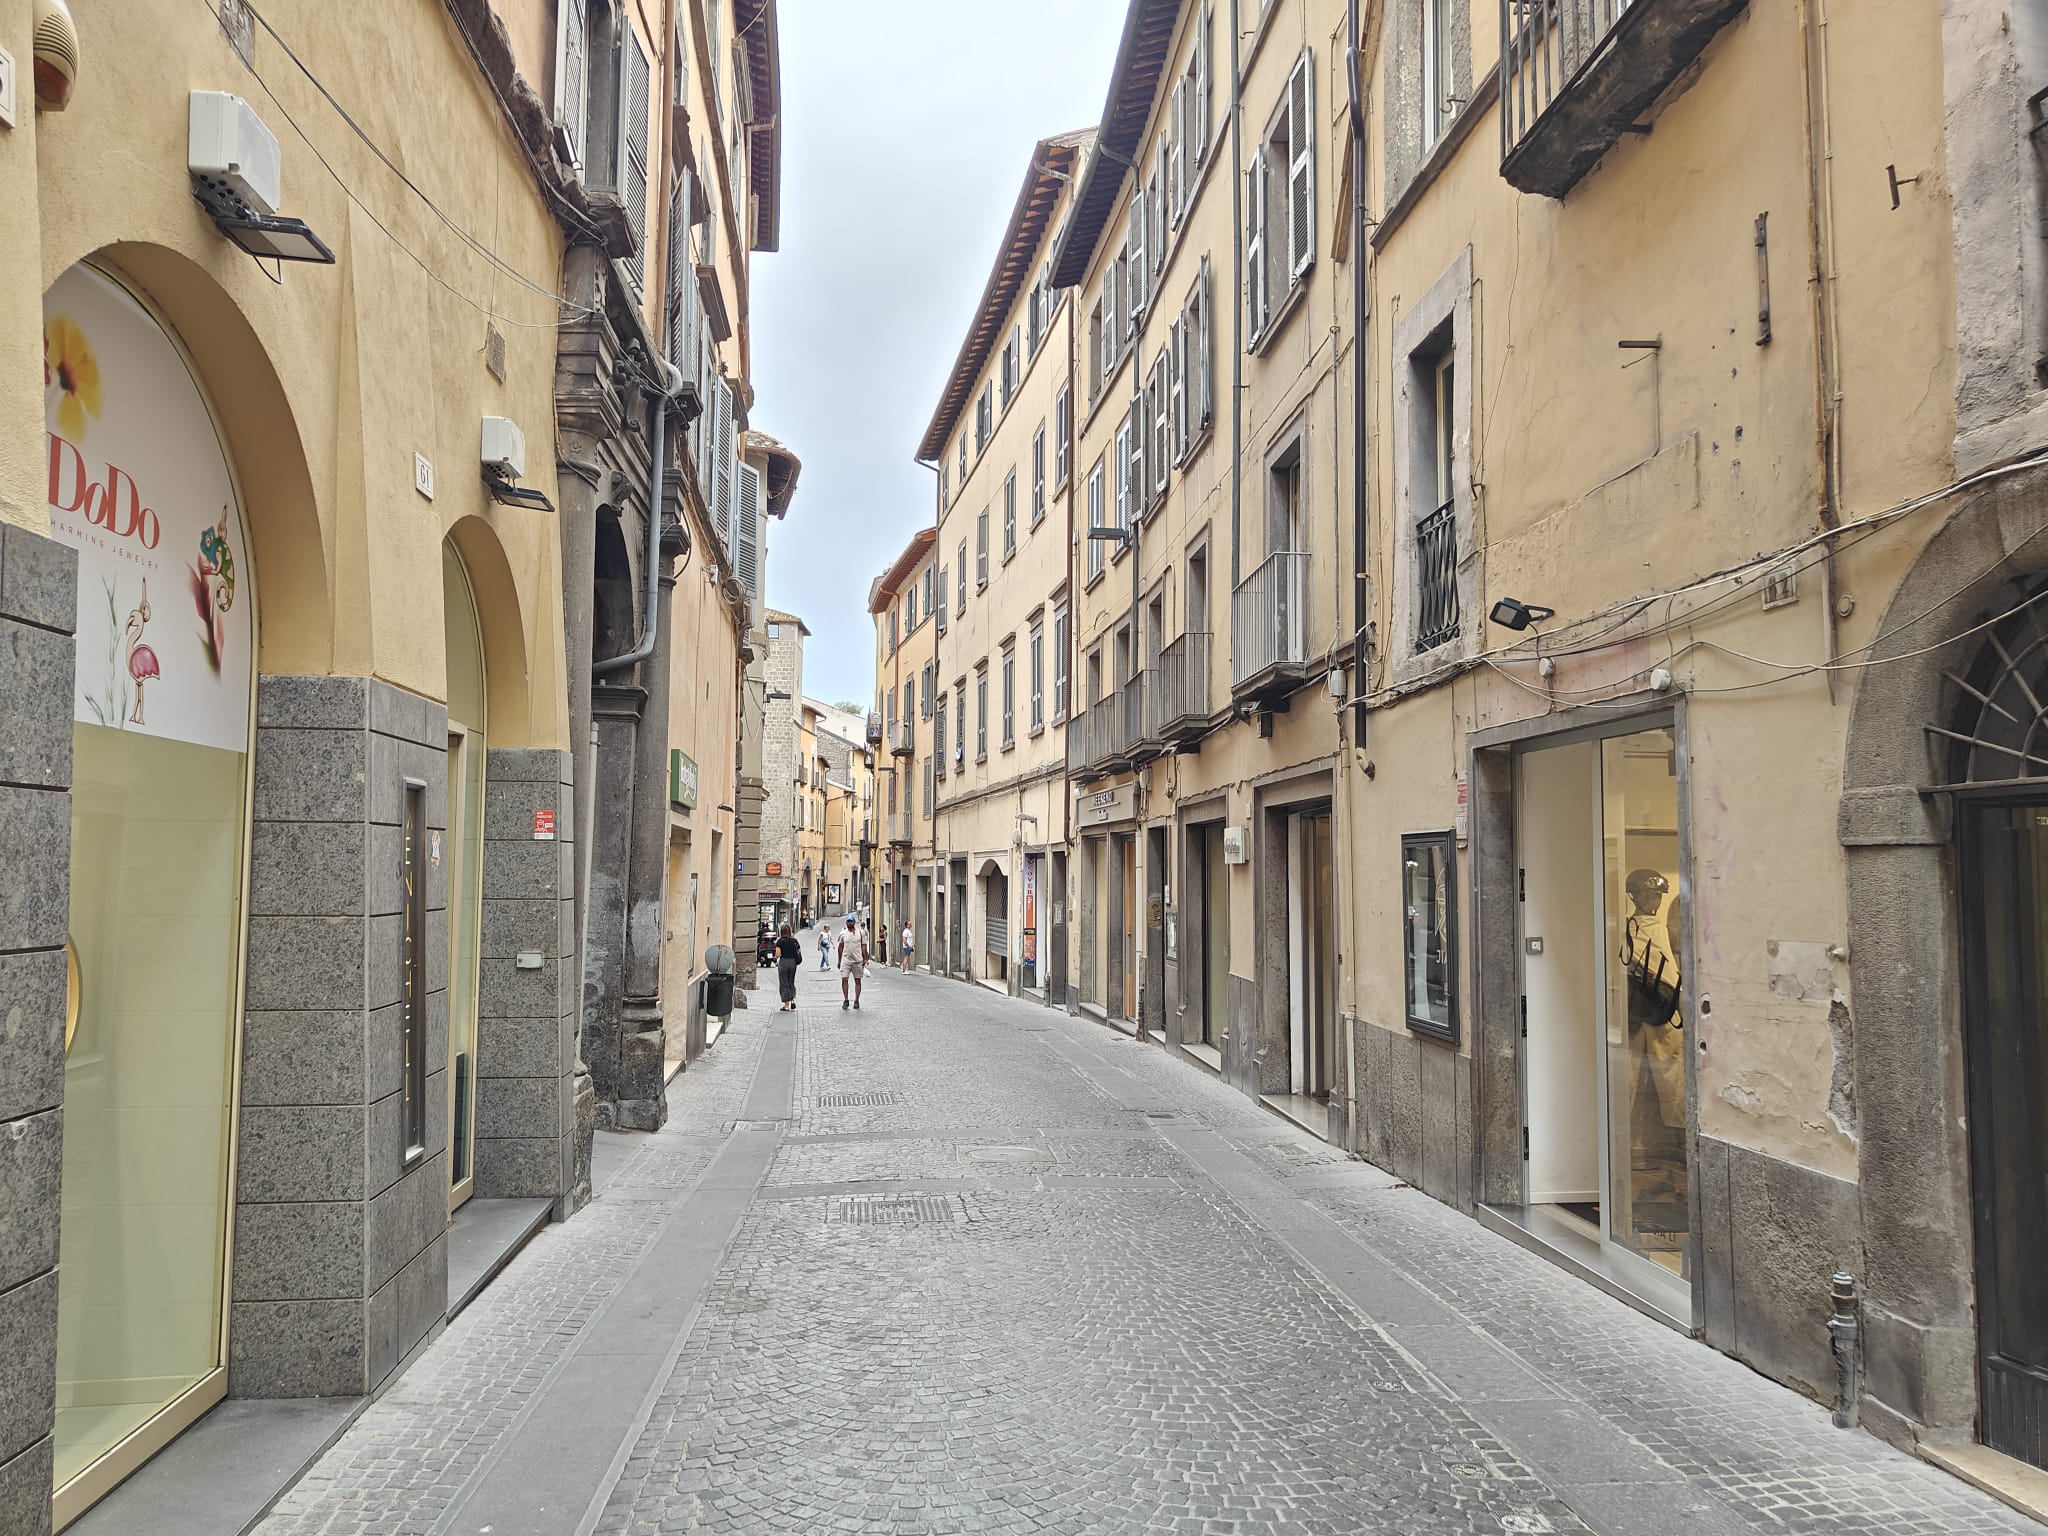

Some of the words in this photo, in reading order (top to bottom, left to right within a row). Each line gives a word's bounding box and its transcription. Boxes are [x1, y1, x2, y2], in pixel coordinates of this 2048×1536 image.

[46, 431, 160, 549] DoDo
[421, 464, 430, 488] 61
[51, 518, 105, 547] HARMING
[112, 544, 159, 569] JEWELRY
